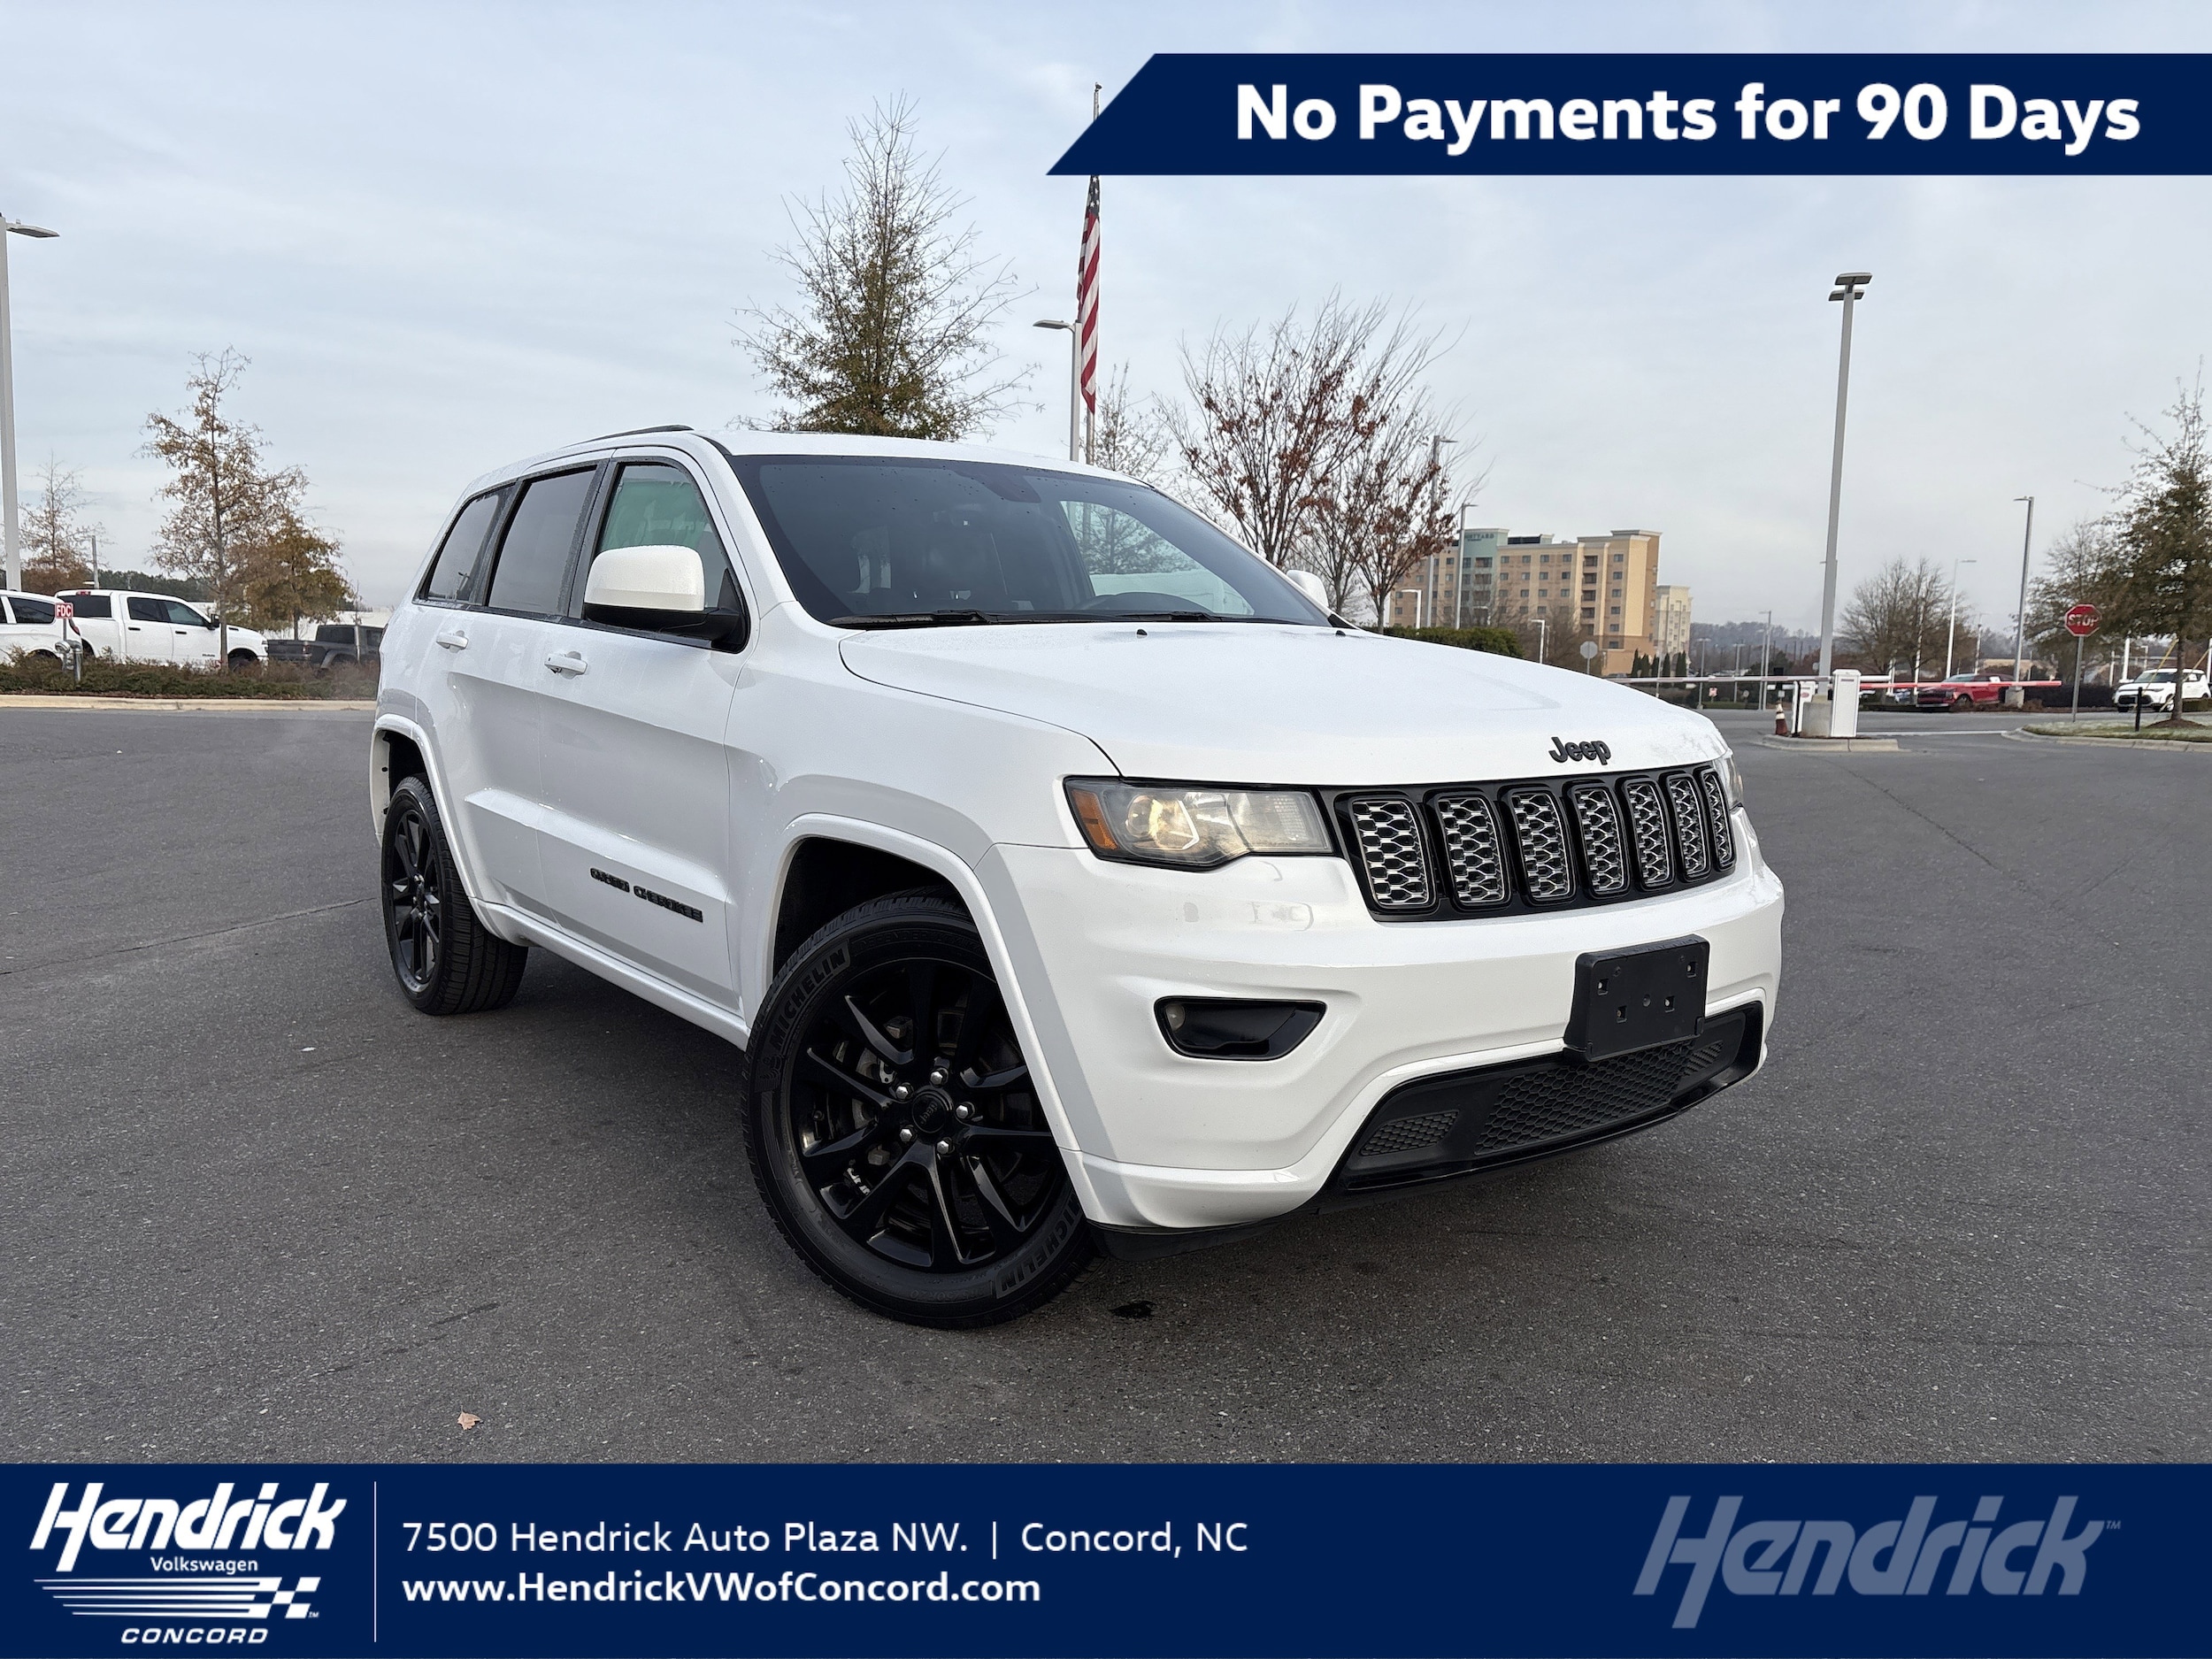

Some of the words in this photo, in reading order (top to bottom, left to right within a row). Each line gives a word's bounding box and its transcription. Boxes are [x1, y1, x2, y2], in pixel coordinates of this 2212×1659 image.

[57, 604, 72, 617] FDC
[1548, 736, 1611, 766] Jeep
[769, 948, 846, 1051] MICHELIN
[1001, 1193, 1081, 1292] MICHELIN
